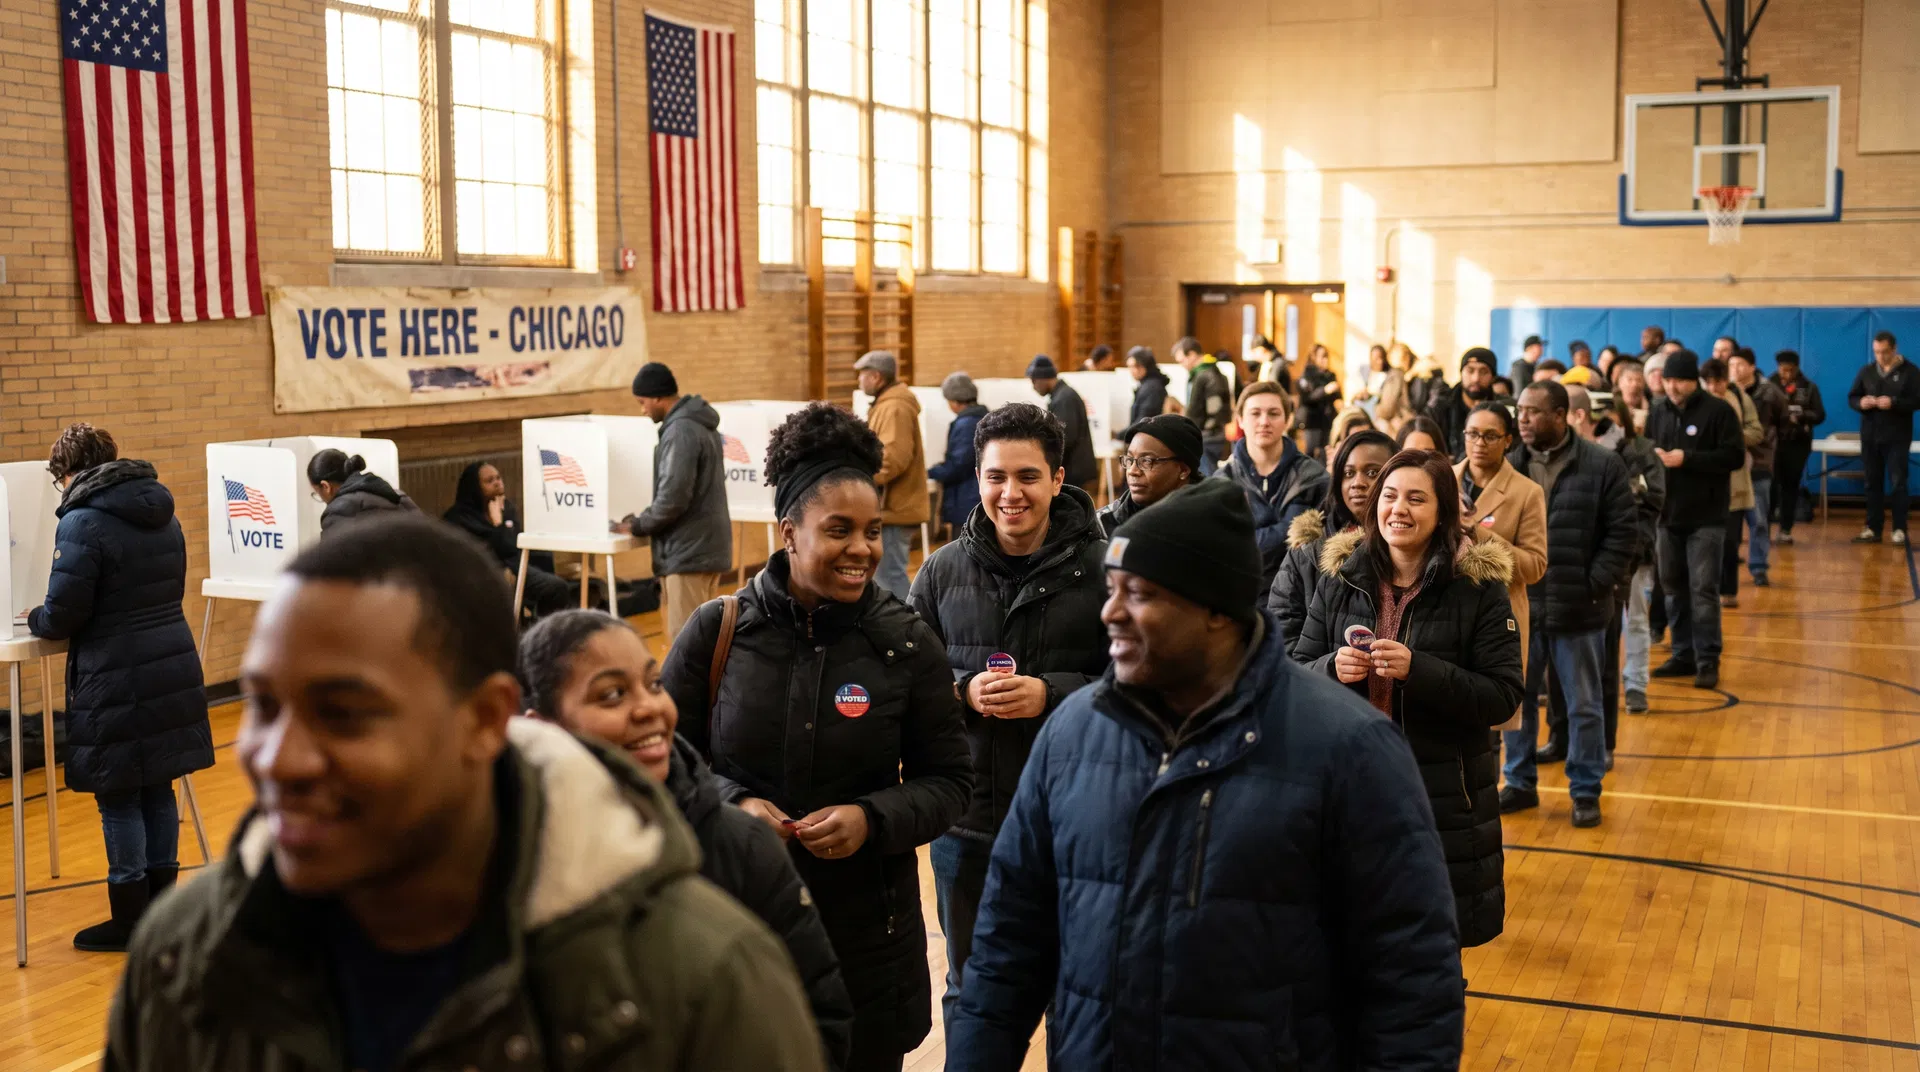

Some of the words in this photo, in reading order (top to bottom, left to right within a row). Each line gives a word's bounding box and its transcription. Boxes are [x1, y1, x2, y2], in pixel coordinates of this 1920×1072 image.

[298, 307, 387, 359] VOTE
[400, 307, 478, 356] HERE
[509, 304, 624, 352] CHICAGO
[554, 491, 594, 508] VOTE
[240, 529, 284, 549] VOTE
